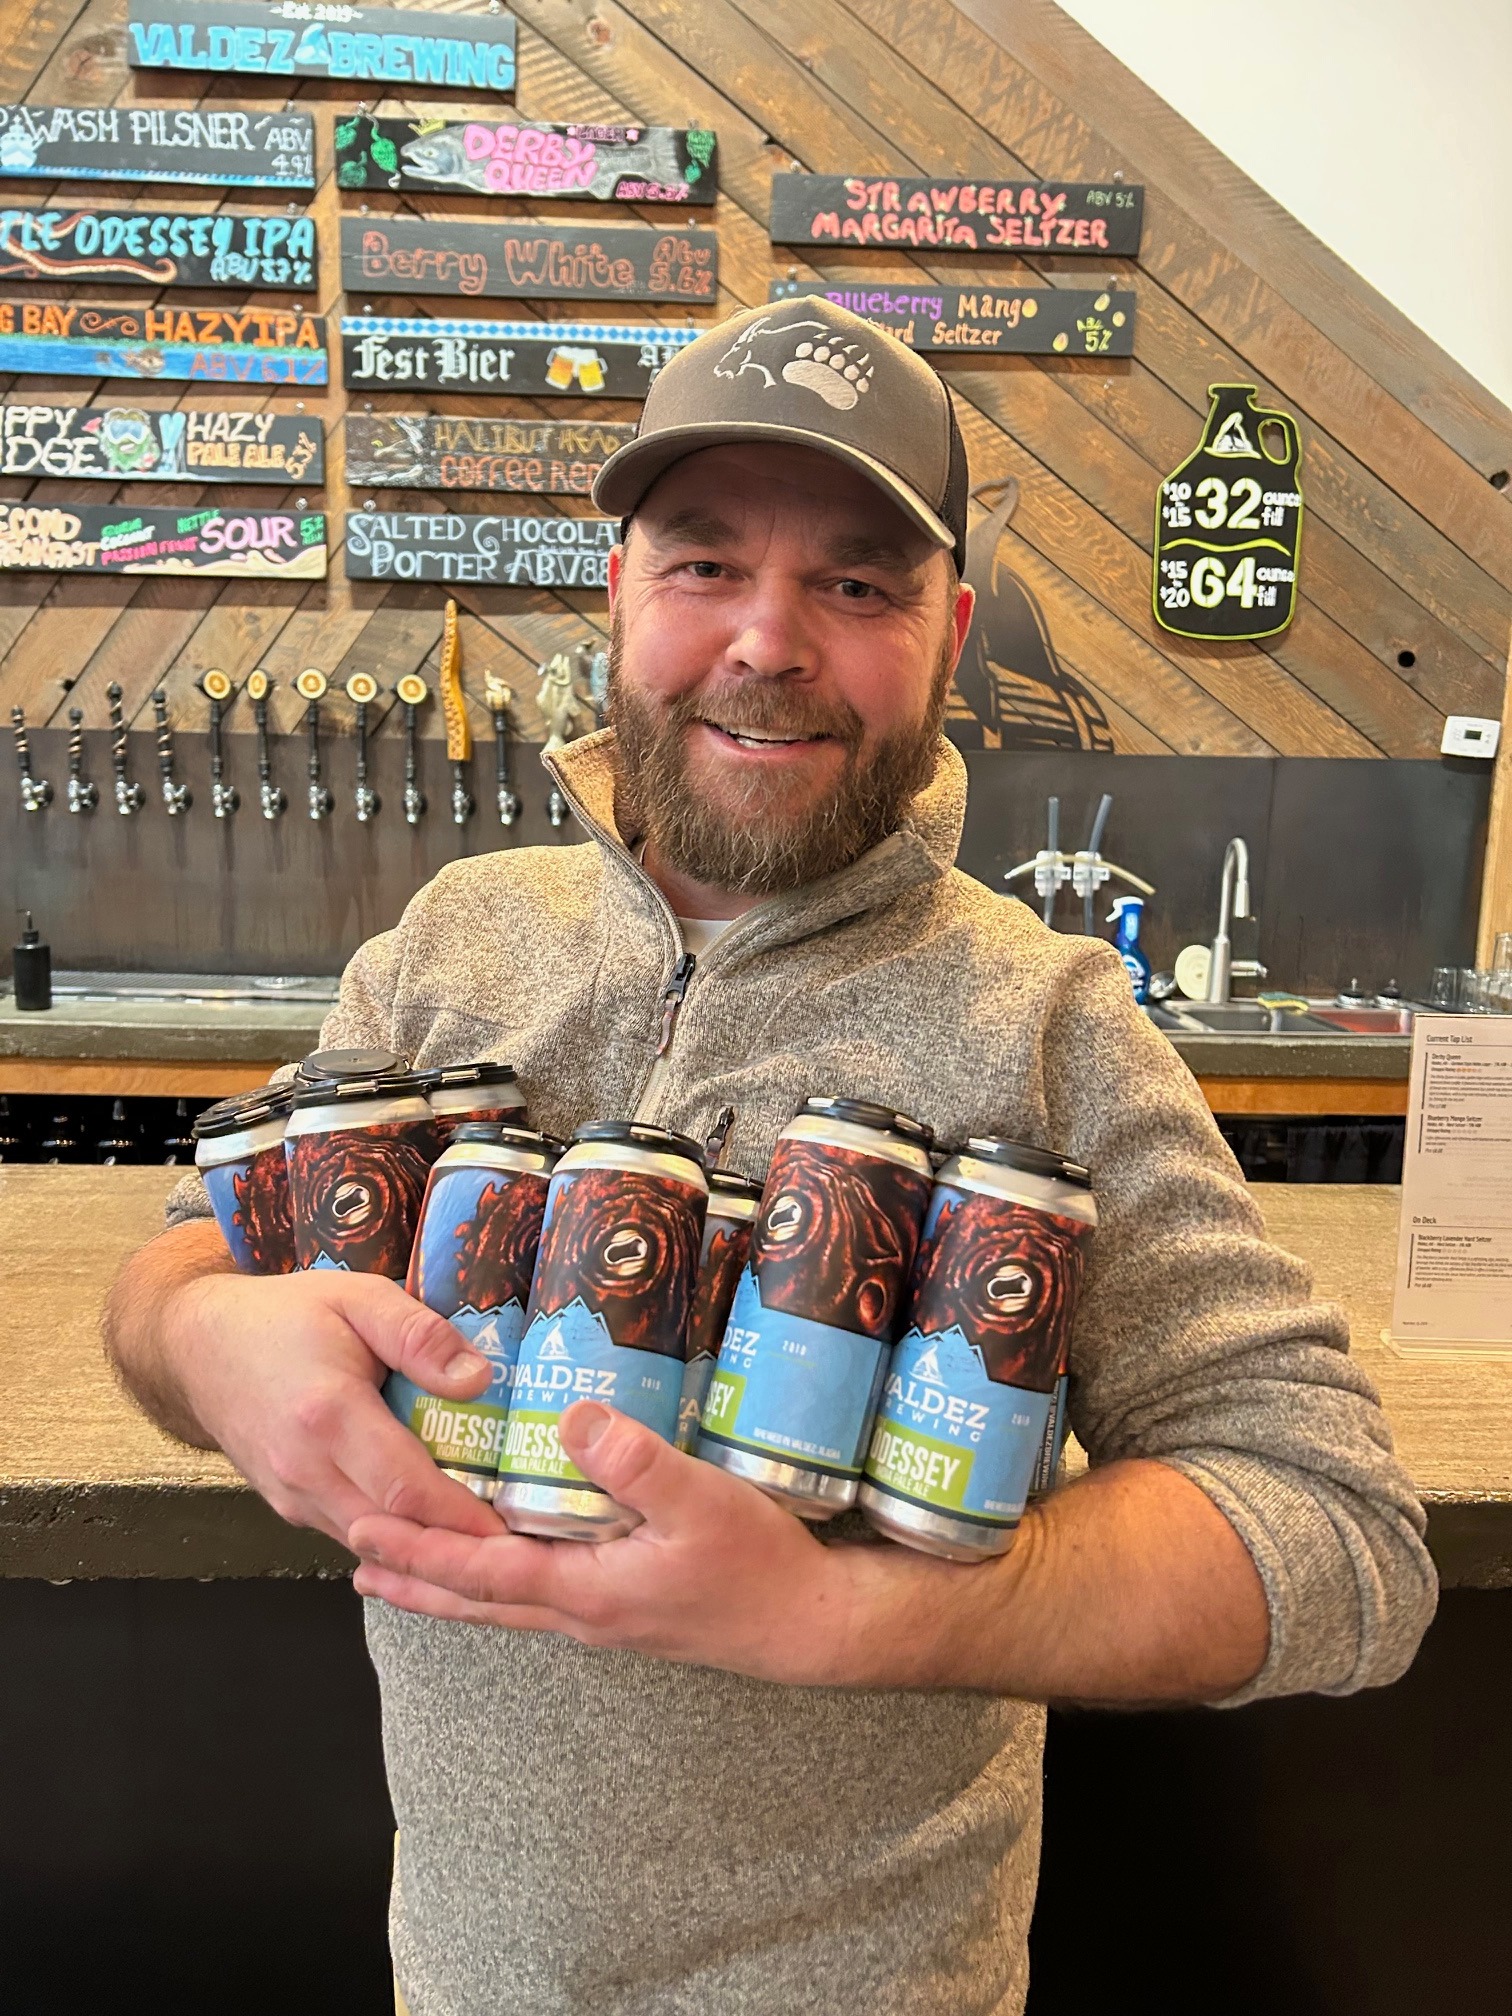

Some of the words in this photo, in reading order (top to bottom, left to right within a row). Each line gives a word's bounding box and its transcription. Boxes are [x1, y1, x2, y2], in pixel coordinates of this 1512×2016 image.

[129, 22, 295, 72] VALDEZ
[329, 29, 515, 91] BREWING
[20, 106, 119, 143] WASH
[129, 110, 255, 150] PILSNER
[263, 126, 313, 152] ABV
[463, 124, 597, 167] DERBY
[485, 159, 598, 190] QUEEN
[843, 178, 1067, 217] STRAWBERRY
[1086, 190, 1113, 207] ABV
[74, 215, 234, 258] ODESSEY
[243, 217, 314, 258] IPA
[811, 211, 977, 249] MARGARITA
[986, 214, 1109, 249] SELTZER
[363, 231, 487, 295] Berry
[504, 238, 635, 288] White
[22, 304, 77, 337] BAY
[145, 309, 250, 344] HAZY
[251, 314, 319, 349] IPA
[880, 319, 915, 344] ard
[932, 320, 1002, 345] Seltzer
[1085, 329, 1113, 352] 5%
[189, 352, 255, 382] ABV
[352, 335, 429, 381] Fest
[432, 338, 515, 384] Bier
[0, 405, 77, 440] PPY
[187, 411, 275, 443] HAZY
[434, 420, 554, 454] HALIBUT
[559, 425, 622, 455] HEAD
[440, 455, 543, 490] COFFEE
[1162, 481, 1192, 502] $10
[1194, 477, 1263, 530] 32
[1162, 506, 1192, 528] $15
[199, 516, 298, 554] SOUR
[347, 514, 466, 556] SALTED
[370, 541, 497, 581] PORTER
[1159, 585, 1190, 609] $20
[1160, 560, 1188, 580] $15
[1190, 556, 1258, 609] 64
[1426, 1034, 1449, 1043] Current
[1450, 1034, 1460, 1043] Tap
[1461, 1035, 1473, 1043] List
[1422, 1216, 1437, 1224] Deck
[415, 1396, 444, 1411] LITTLE
[436, 1444, 460, 1458] INDIA
[462, 1446, 483, 1461] PALE
[483, 1451, 498, 1464] ALE
[505, 1421, 571, 1461] ODESS
[870, 1427, 960, 1491] ODESSEY
[528, 1457, 548, 1473] PALE
[552, 1461, 564, 1474] ALE
[893, 1471, 912, 1491] PALE
[913, 1482, 930, 1498] ALE
